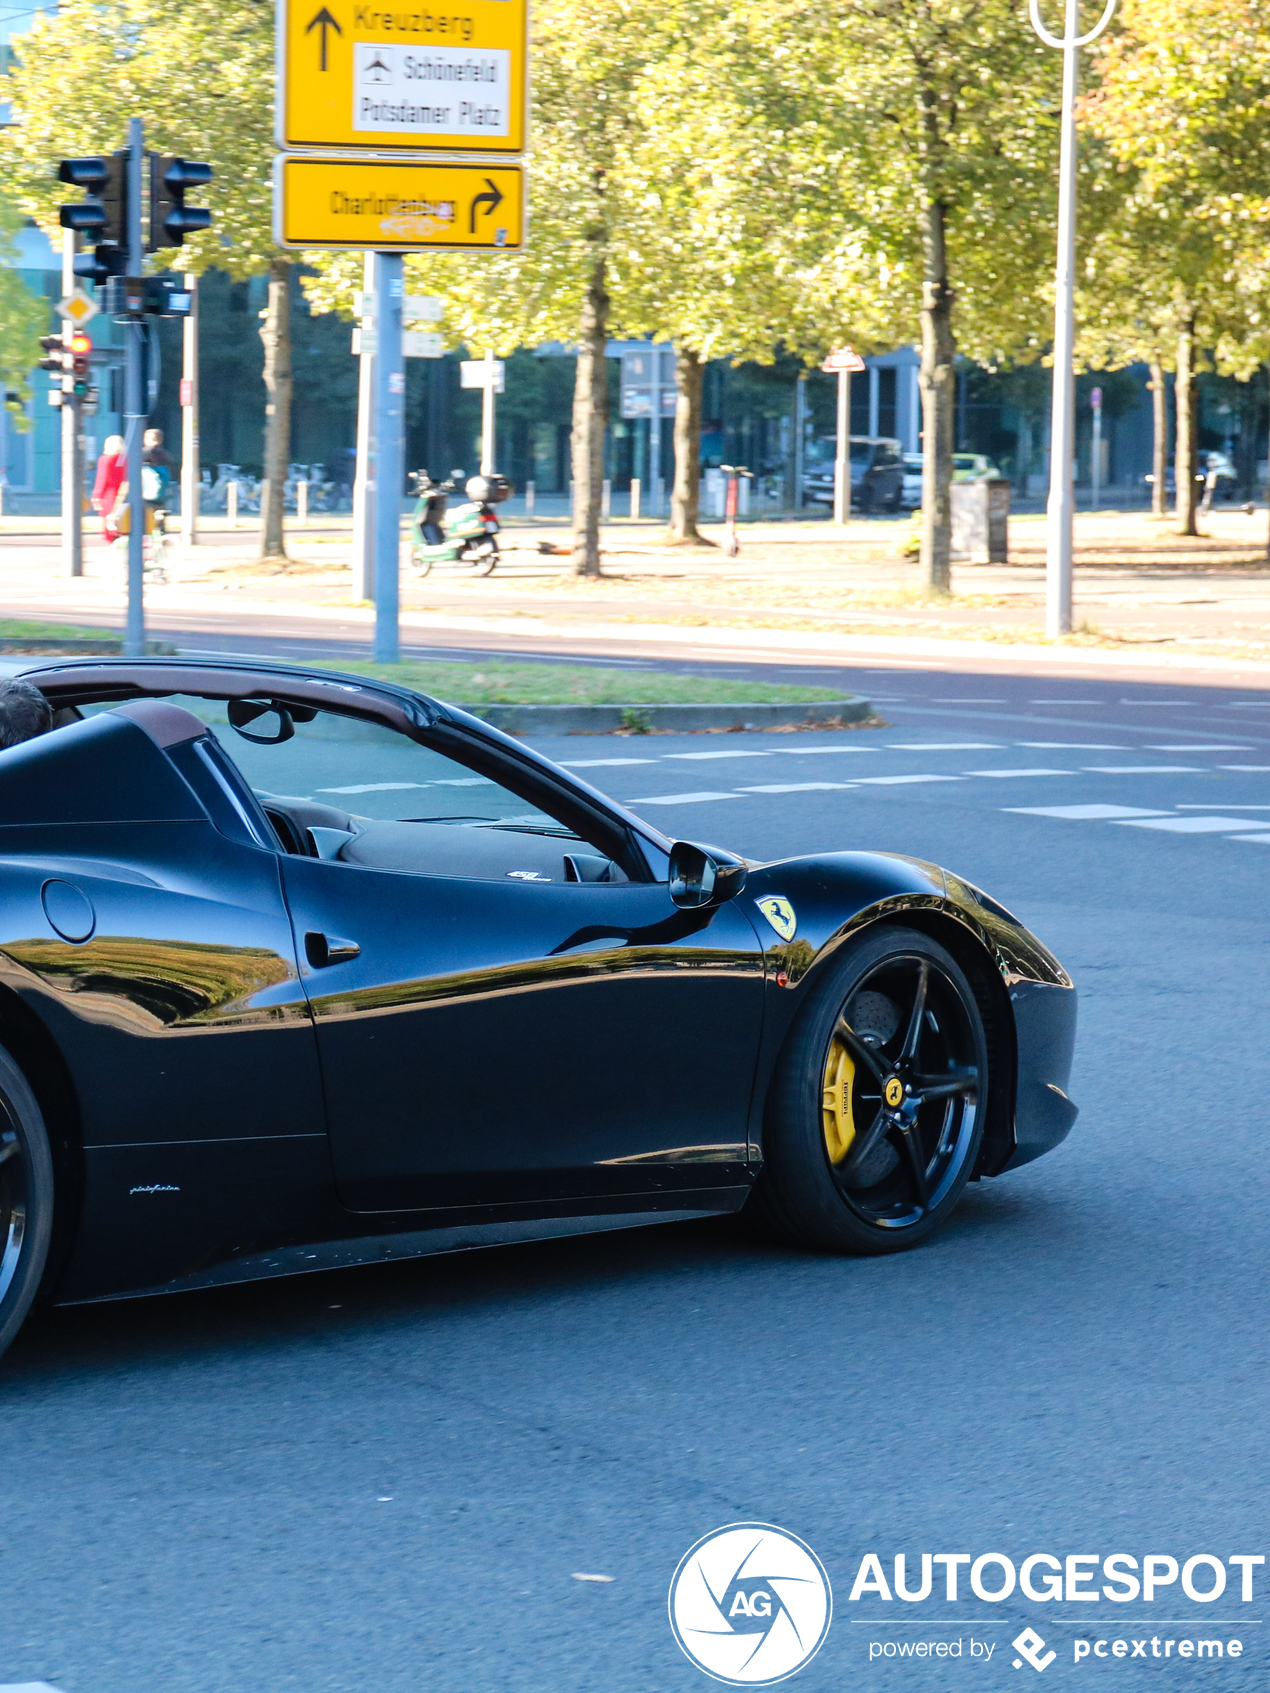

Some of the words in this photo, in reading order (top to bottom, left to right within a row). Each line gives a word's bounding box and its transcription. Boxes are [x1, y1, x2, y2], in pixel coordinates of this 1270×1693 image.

[353, 5, 474, 41] Kreuzberg
[404, 55, 498, 83] Schönefeld
[360, 96, 451, 124] Potsdamer
[459, 101, 501, 126] Platz
